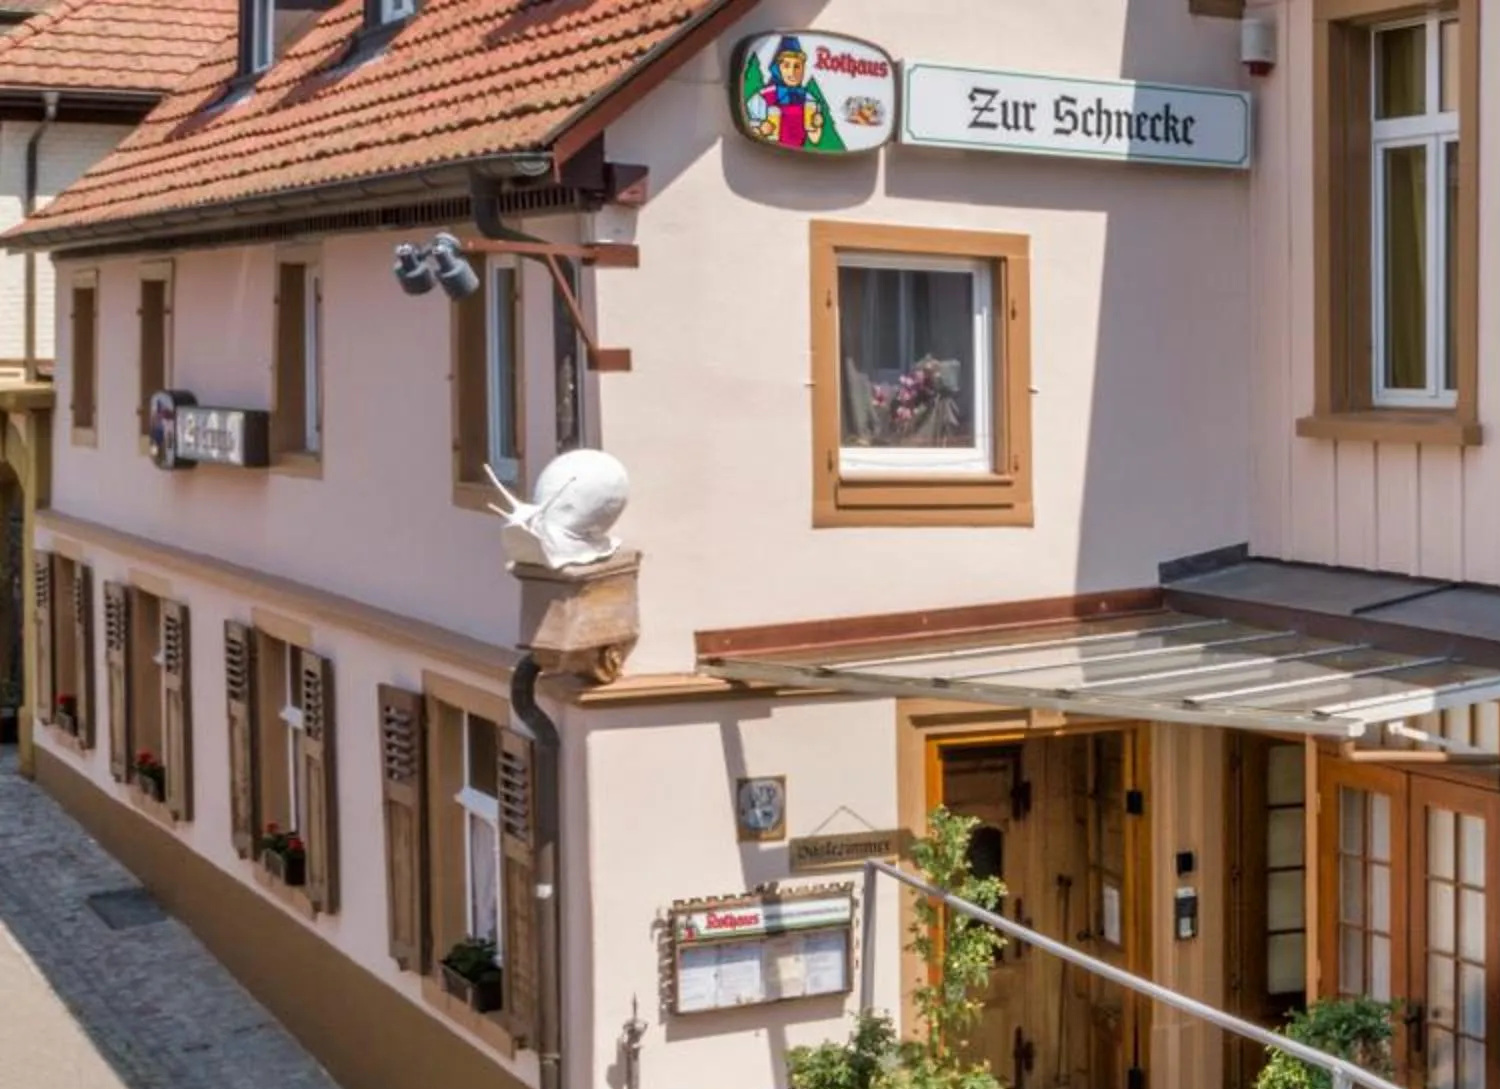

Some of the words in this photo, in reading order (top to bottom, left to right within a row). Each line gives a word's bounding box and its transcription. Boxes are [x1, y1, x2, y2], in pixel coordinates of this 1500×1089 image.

[815, 46, 888, 78] Rothaus
[968, 87, 1037, 132] Zur
[1053, 95, 1195, 145] Schnecke
